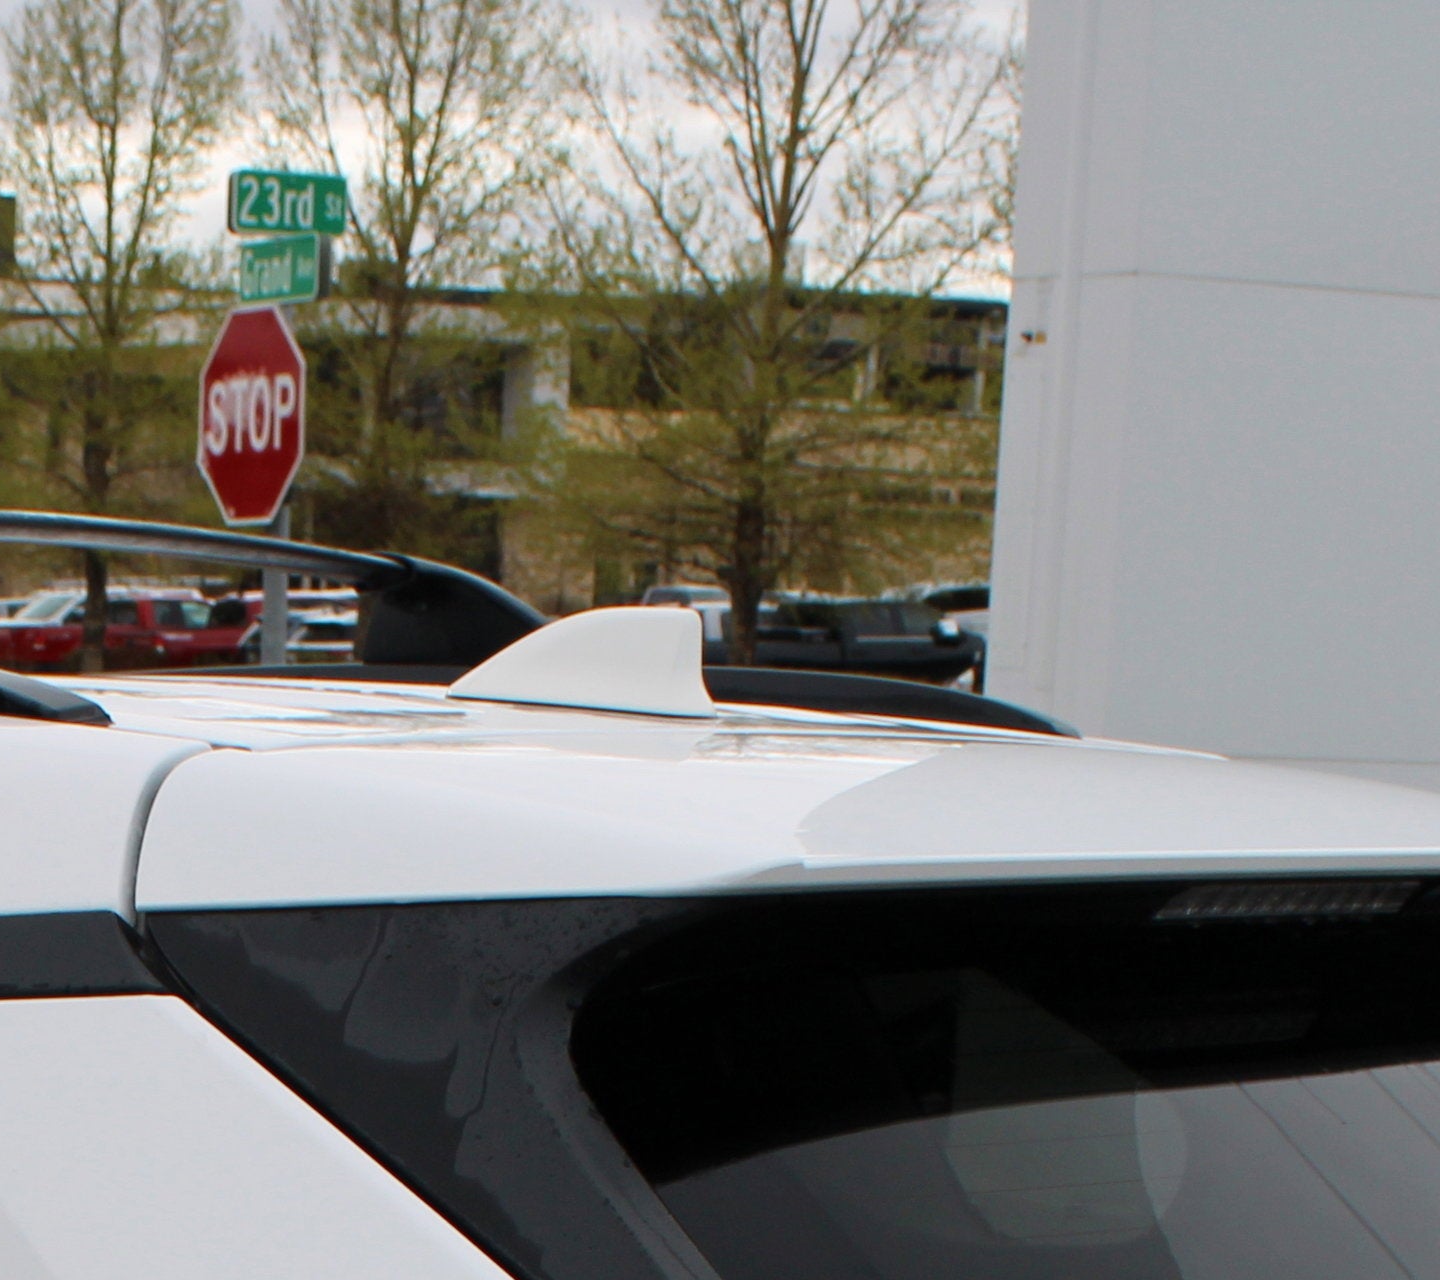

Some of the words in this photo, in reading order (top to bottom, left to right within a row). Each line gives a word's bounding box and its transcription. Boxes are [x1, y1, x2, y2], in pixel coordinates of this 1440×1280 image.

[239, 175, 315, 229] 23rd
[241, 248, 293, 299] Grand
[206, 373, 296, 456] STOP
